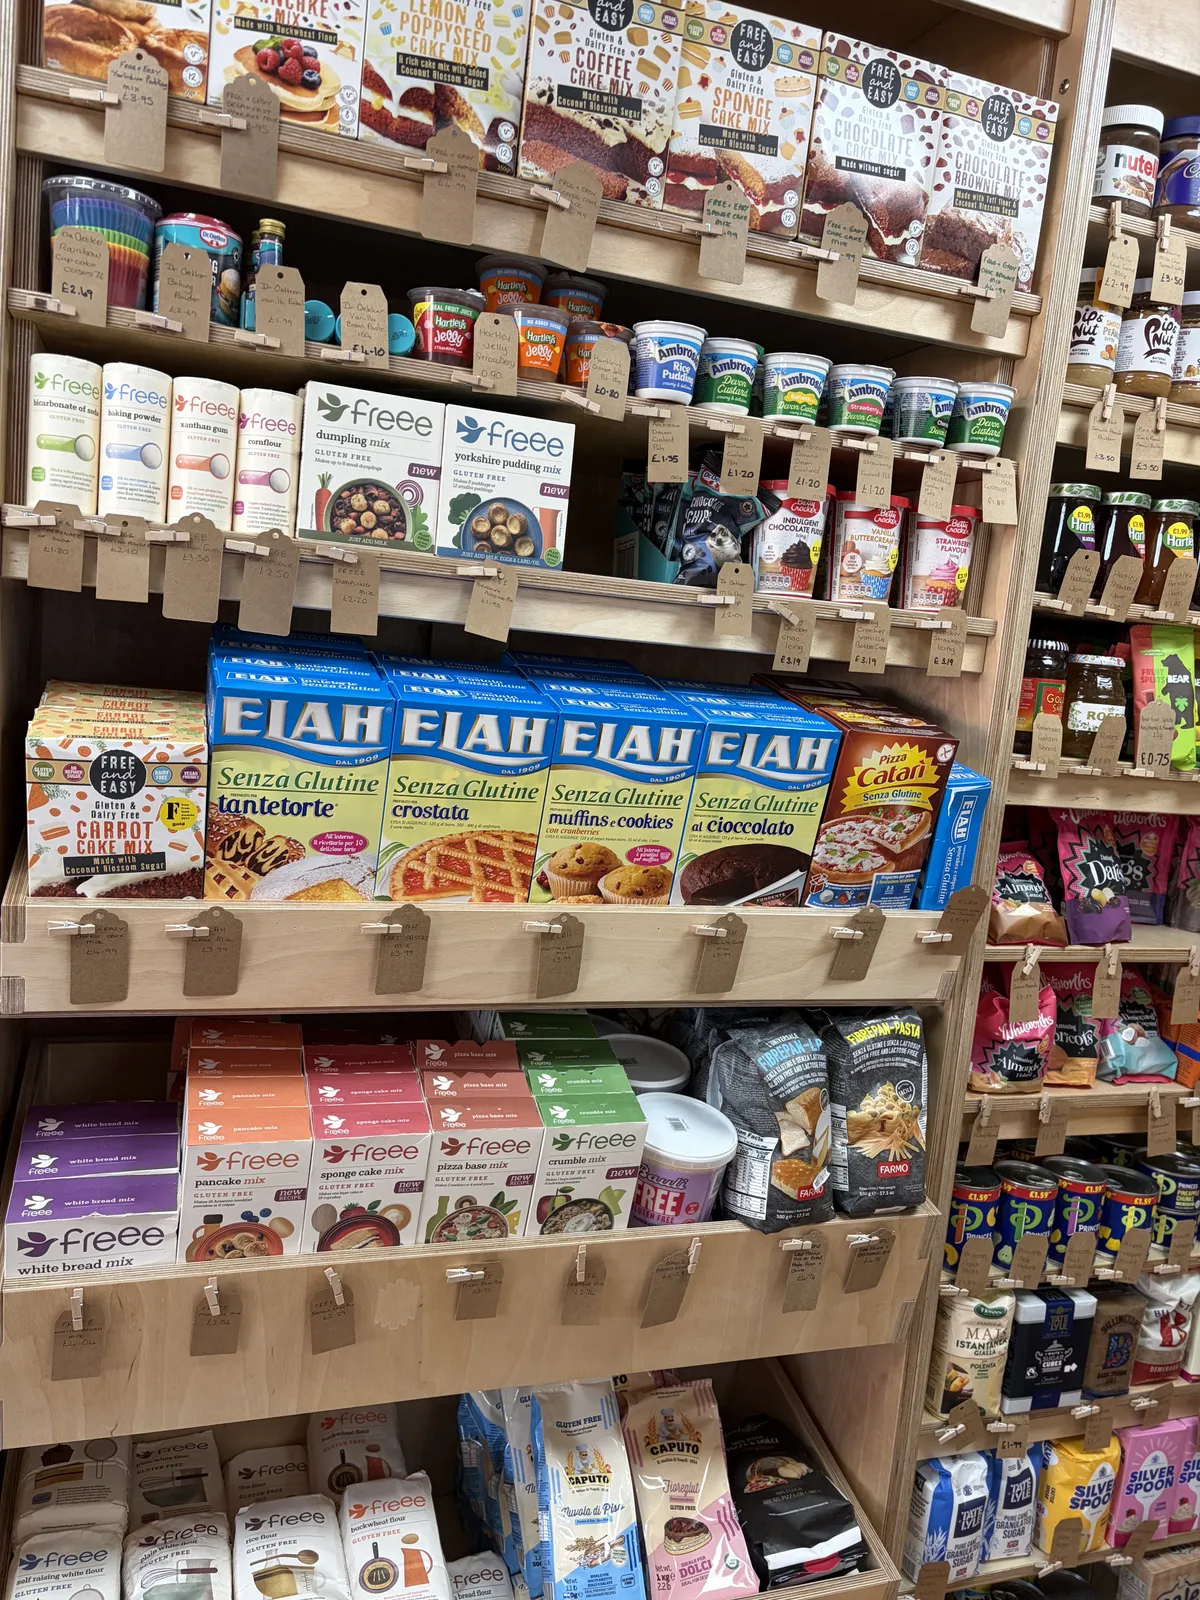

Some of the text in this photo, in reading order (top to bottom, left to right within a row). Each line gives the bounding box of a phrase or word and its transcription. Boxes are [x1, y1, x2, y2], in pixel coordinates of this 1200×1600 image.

[234, 18, 338, 44] Made with Buckwheat Flour
[400, 13, 492, 54] POPPYSEED
[410, 36, 478, 66] CAKE MIX
[575, 47, 633, 80] COFFEE
[570, 67, 634, 97] CAKE MIX
[582, 90, 619, 105] Made with
[713, 86, 773, 120] SPONGE
[557, 96, 641, 120] Coconut Blossom Sugar
[712, 107, 770, 135] CAKE MIX
[834, 118, 913, 157] CHOCOLATE
[841, 159, 900, 177] Made without sugar
[955, 151, 1026, 188] CHOCOLATE
[955, 170, 1021, 200] BROWNIE MIX
[61, 282, 94, 300] £2.69
[434, 315, 467, 330] Hartley's
[535, 320, 548, 328] ADDED
[434, 328, 464, 348] Jelly
[478, 328, 511, 342] Hartley
[673, 361, 691, 374] Rice
[51, 373, 100, 400] freee
[722, 375, 748, 389] Devon
[717, 384, 751, 398] Custard
[33, 398, 100, 417] bicarbonate of soda
[108, 408, 162, 424] baking powder
[351, 399, 433, 437] freee
[180, 422, 228, 435] xanthan gum
[248, 438, 282, 448] cornflour
[315, 430, 391, 449] dumpling mix
[315, 448, 372, 462] GLUTEN FREE
[455, 451, 562, 475] yorkshire pudding mix
[411, 465, 437, 477] new
[544, 485, 567, 497] new
[768, 523, 809, 533] CHOCOLATE
[782, 517, 820, 527] INDULGENT
[871, 528, 897, 537] VANILLA
[348, 536, 362, 544] JUST
[940, 545, 967, 555] FLAVOUR
[1167, 674, 1190, 683] BEAR
[222, 697, 386, 744] ELAH
[101, 756, 136, 770] FREE
[354, 754, 379, 765] 1909
[879, 751, 907, 766] Pizza
[102, 769, 136, 779] and
[218, 768, 379, 792] Senza Glutine
[100, 781, 137, 793] EASY
[863, 789, 922, 802] Senza Glutine
[95, 801, 136, 810] Gluten &
[218, 794, 335, 818] tantetorte
[392, 804, 470, 821] crostata
[91, 811, 140, 820] Dairy Free
[548, 810, 673, 830] muffins e cookies
[77, 821, 153, 839] CARROT
[562, 827, 599, 836] cranberries
[691, 817, 794, 836] al cioccolato
[77, 840, 153, 854] CAKE MIX
[846, 1022, 922, 1046] FIBREPAN-PASTA
[437, 1161, 508, 1173] pizza base mix
[548, 1155, 607, 1166] crumble mix
[321, 1166, 405, 1180] sponge cake mix
[610, 1167, 635, 1178] new
[880, 1164, 908, 1175] FARMO
[195, 1176, 266, 1188] pancake mix
[64, 1199, 89, 1207] white
[117, 1196, 135, 1204] mix
[60, 1226, 165, 1254] freee
[18, 1256, 134, 1275] white bread mix
[556, 1415, 602, 1428] GLUTEN FREE
[650, 1443, 699, 1455] CAPUTO
[569, 1475, 610, 1485] CAPUTO
[1130, 1466, 1175, 1483] SILVER
[1125, 1477, 1174, 1496] SPOON
[371, 1495, 426, 1513] freee
[350, 1515, 406, 1533] buckwheat flour
[245, 1531, 278, 1544] rice flour
[352, 1532, 381, 1544] GLUTEN
[1002, 1528, 1025, 1539] SUGAR
[16, 1567, 105, 1585] self raising white flour
